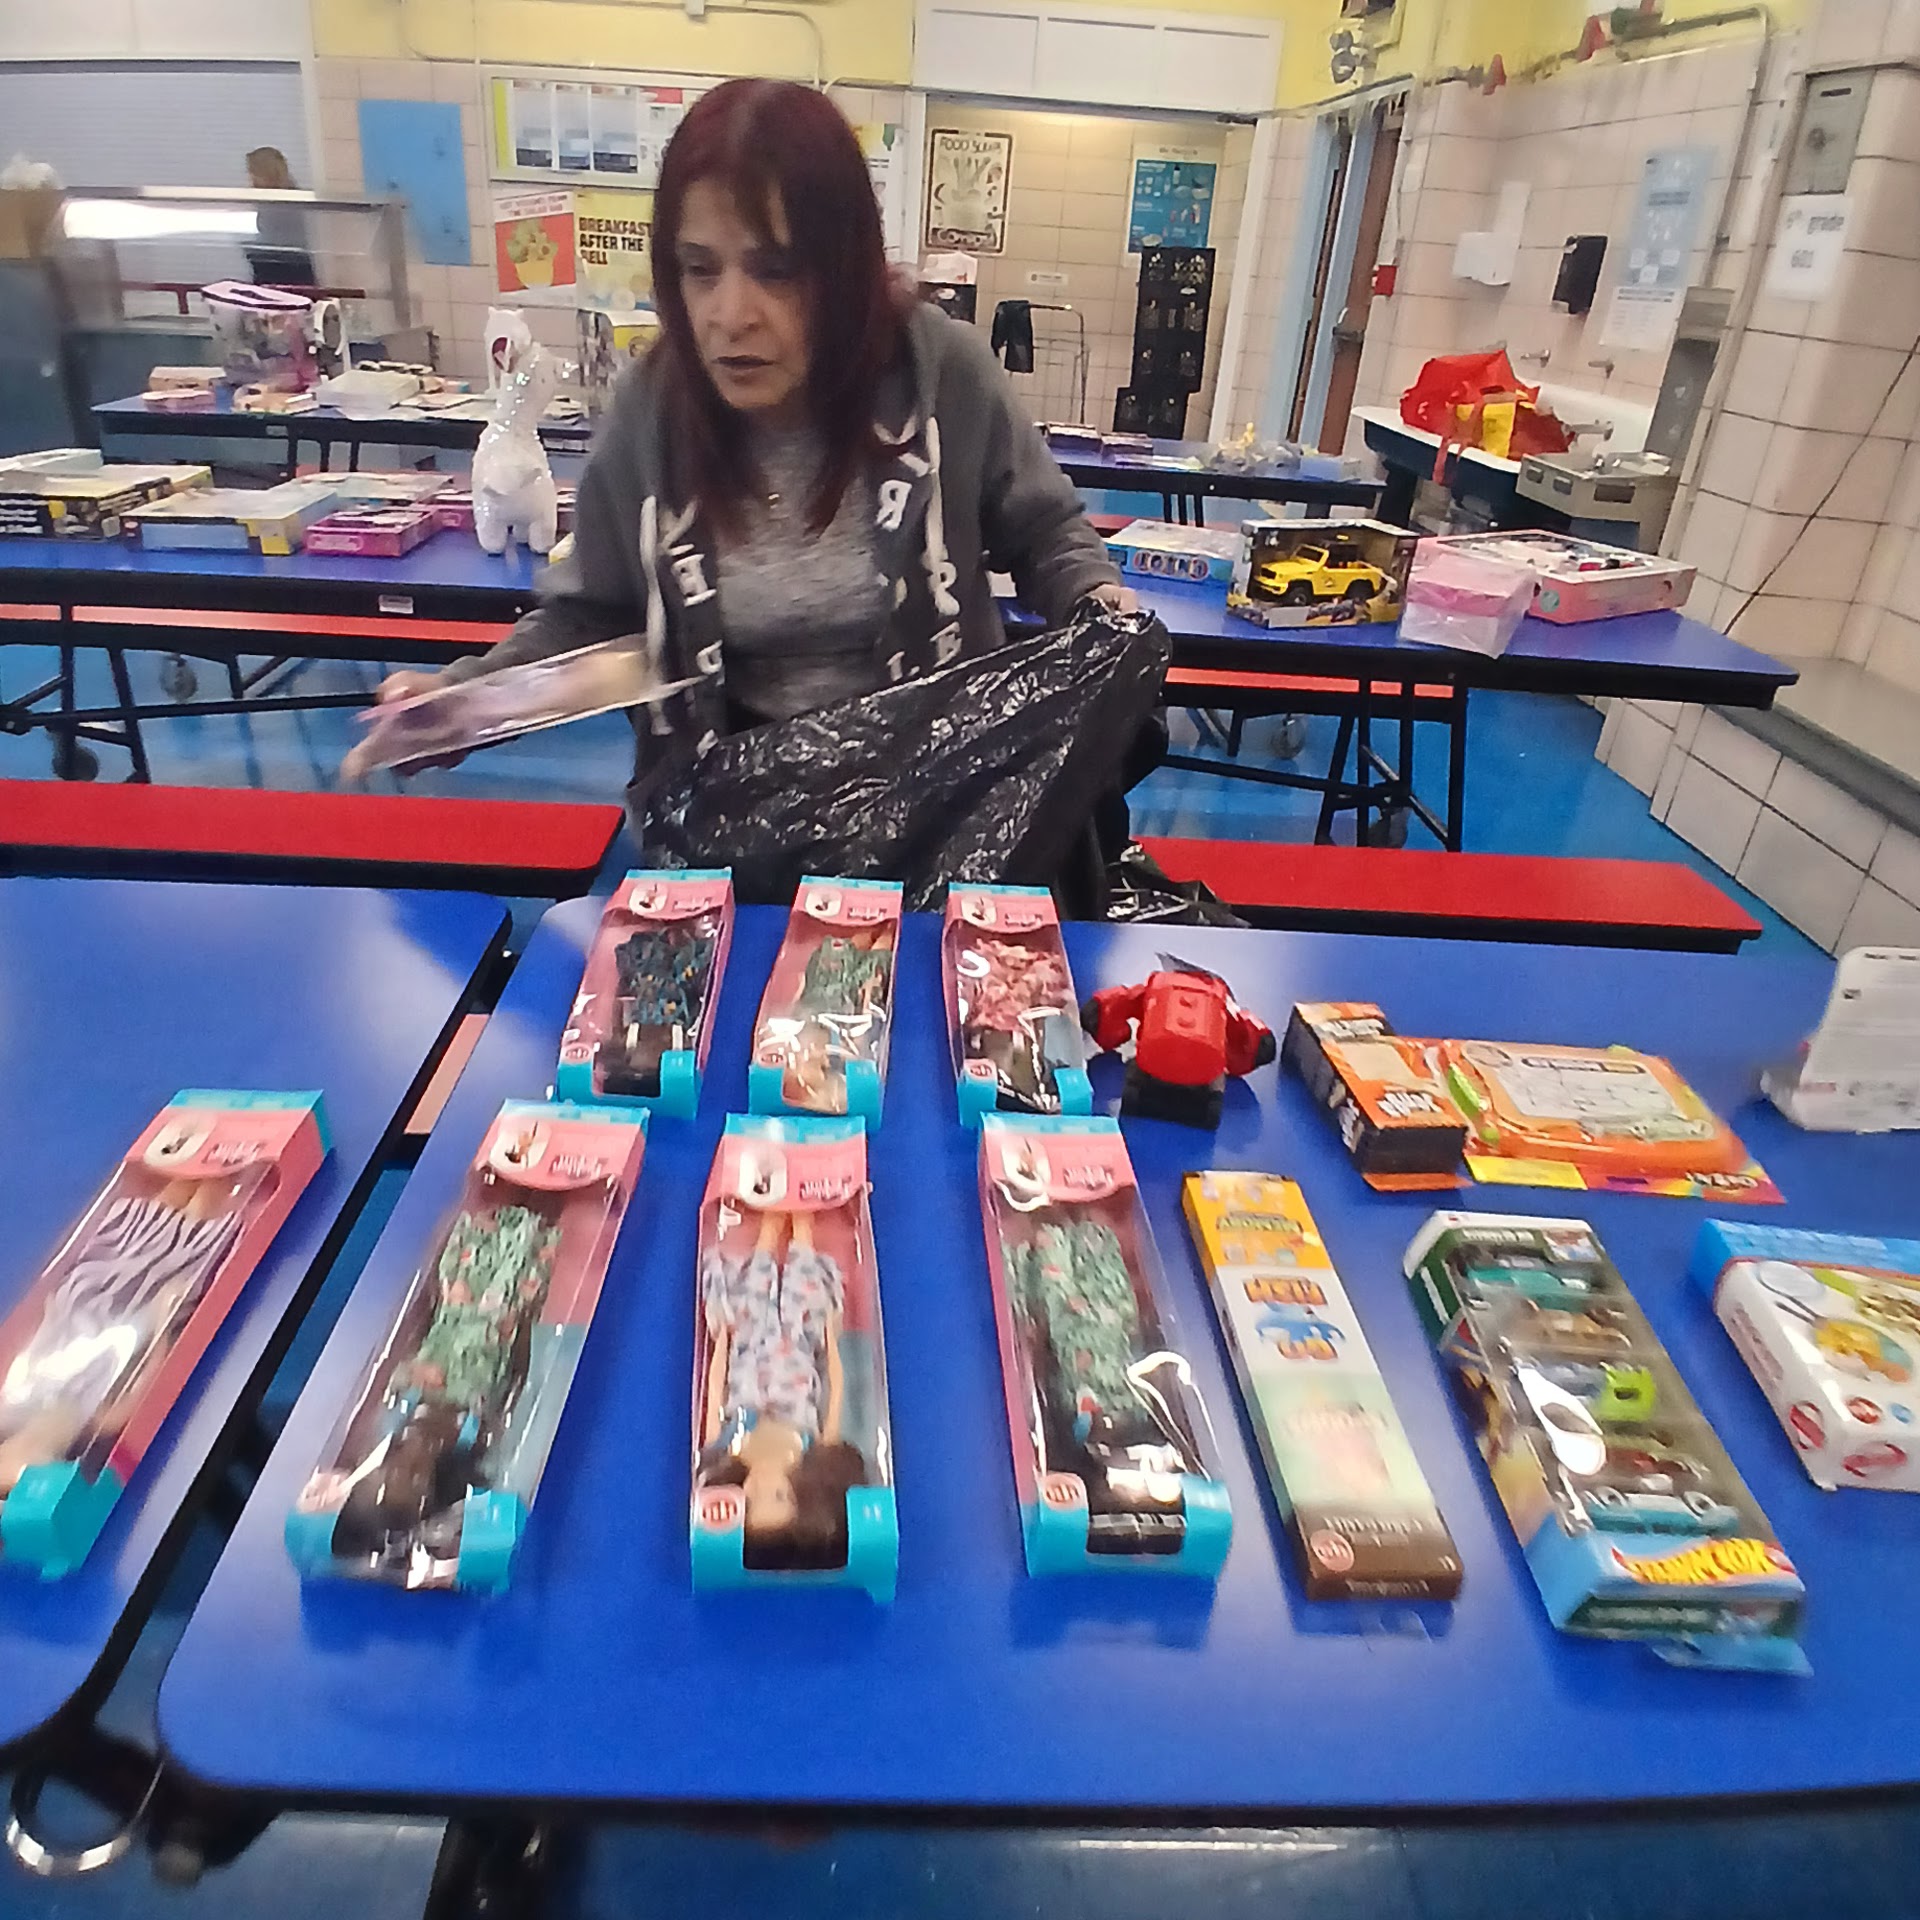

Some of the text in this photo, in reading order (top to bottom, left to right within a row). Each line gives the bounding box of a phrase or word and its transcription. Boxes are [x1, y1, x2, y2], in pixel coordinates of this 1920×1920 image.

[579, 217, 652, 237] BREAKFAST
[580, 233, 644, 252] AFTER THE
[1243, 1277, 1328, 1306] FISH
